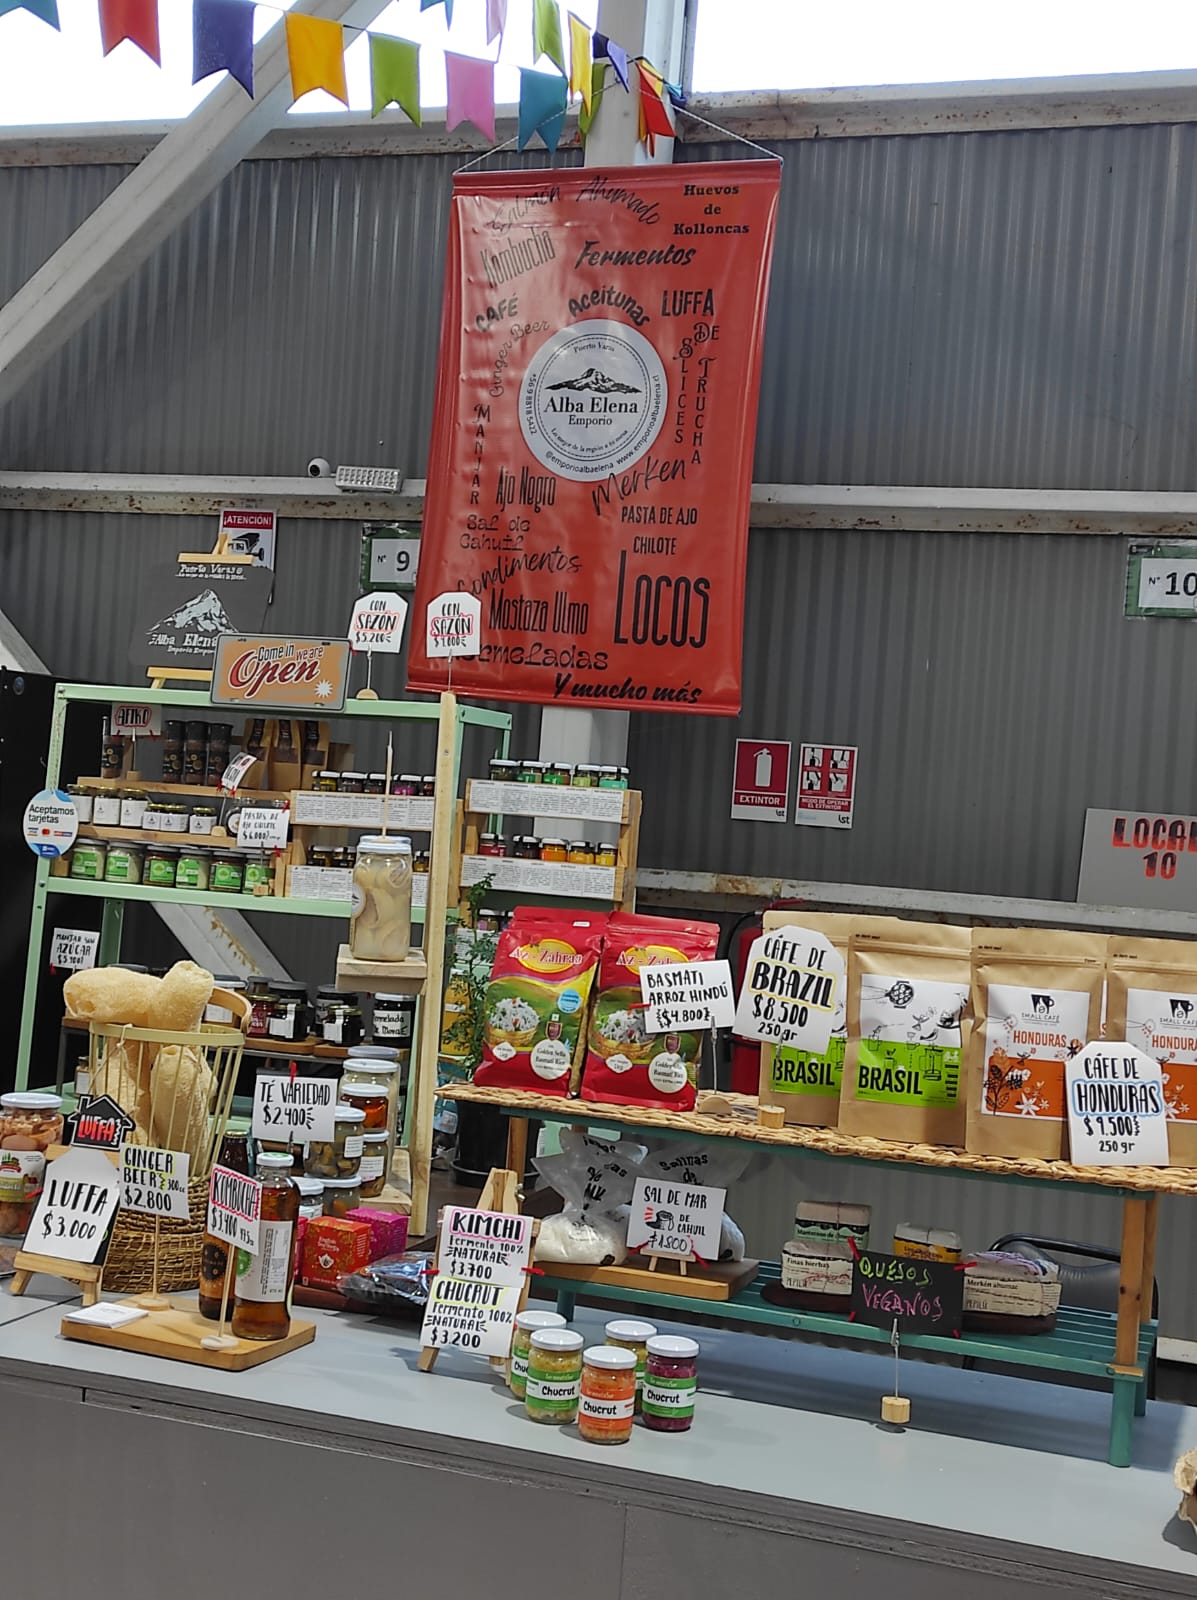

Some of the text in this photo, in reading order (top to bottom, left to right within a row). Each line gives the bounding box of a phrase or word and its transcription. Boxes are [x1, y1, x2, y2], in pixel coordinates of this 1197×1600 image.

[575, 176, 661, 225] Ahumado
[684, 183, 739, 197] Huevos
[703, 204, 721, 216] de
[674, 223, 749, 235] Kolloncas
[480, 226, 556, 288] Kombucha
[574, 240, 697, 270] Fermentos
[476, 293, 519, 332] CAFÉ
[568, 284, 650, 327] Aceitunas
[661, 288, 714, 317] LUFFA
[489, 319, 550, 398] Ginger Beer
[573, 343, 596, 353] Puerto
[672, 322, 720, 464] SLICES DE TRUCHA
[544, 396, 638, 413] Alba Elena
[568, 414, 613, 428] Emporio
[470, 403, 491, 505] MANJAR
[545, 450, 614, 473] @emporioalbaelena
[496, 466, 557, 513] Ajo Negro
[591, 455, 686, 516] Merken
[466, 514, 530, 532] Sal de
[621, 506, 698, 525] PASTA DE AJO
[633, 536, 677, 555] CHILOTE
[396, 550, 410, 572] 9
[1165, 572, 1197, 596] 10
[370, 600, 387, 611] CON
[442, 603, 461, 617] CON
[489, 588, 589, 636] Mostaza Ulmo
[358, 611, 397, 631] SAZÓN
[433, 614, 471, 636] SAZÓN
[155, 634, 175, 645] Alba
[258, 640, 323, 661] Come in we are
[229, 651, 320, 698] Open
[554, 673, 702, 704] Y mucho más
[29, 804, 75, 816] Aceptamos
[739, 795, 780, 805] EXTINTOR
[28, 815, 59, 824] tarjetas
[1143, 851, 1177, 880] 10
[56, 942, 91, 956] AZÚCAR
[616, 951, 635, 965] Az
[807, 947, 827, 971] DE
[647, 970, 703, 988] BASMATI
[751, 961, 833, 1008] BRAZIL
[649, 981, 728, 1006] ARROZ HINDÚ
[661, 1008, 702, 1028] $4.800
[752, 993, 809, 1027] $8.500
[757, 1022, 781, 1037] 250
[1013, 1030, 1067, 1048] HONDURAS
[773, 1057, 835, 1086] BRASIL
[858, 1065, 923, 1095] BRASIL
[1123, 1058, 1140, 1080] DE
[260, 1080, 331, 1106] TÉ VARIEDAD
[1077, 1083, 1160, 1114] HONDURAS
[263, 1104, 306, 1126] $2.400
[77, 1114, 116, 1141] LUFFA
[1099, 1141, 1135, 1154] 250 gr
[125, 1147, 173, 1174] GINGER
[123, 1167, 157, 1190] BEER
[47, 1179, 108, 1216] LUFFA
[124, 1185, 172, 1212] $2.800
[214, 1172, 257, 1217] KOMBUCHA
[644, 1186, 707, 1209] SAL DE MAR
[42, 1211, 97, 1239] $3.000
[211, 1205, 238, 1238] $3.400
[452, 1212, 522, 1240] KIMCHI
[677, 1222, 706, 1236] CAHUIL
[679, 1214, 690, 1223] DE
[449, 1235, 524, 1254] Fermento 100%
[452, 1248, 503, 1265] NATURAL
[787, 1258, 830, 1269] Finas hierbas
[450, 1259, 492, 1279] $3.700
[859, 1257, 932, 1287] QUESOS
[436, 1280, 504, 1306] CHUCRUT
[967, 1279, 992, 1288] Merkén
[432, 1302, 512, 1324] Fermento 100%
[862, 1283, 944, 1322] VEGANOS
[432, 1315, 480, 1332] NATURAL
[431, 1327, 481, 1348] $3.200
[514, 1360, 528, 1373] Chuc
[541, 1385, 575, 1397] Chucrut
[647, 1389, 681, 1404] Chucrut
[583, 1400, 617, 1415] Chucrut
